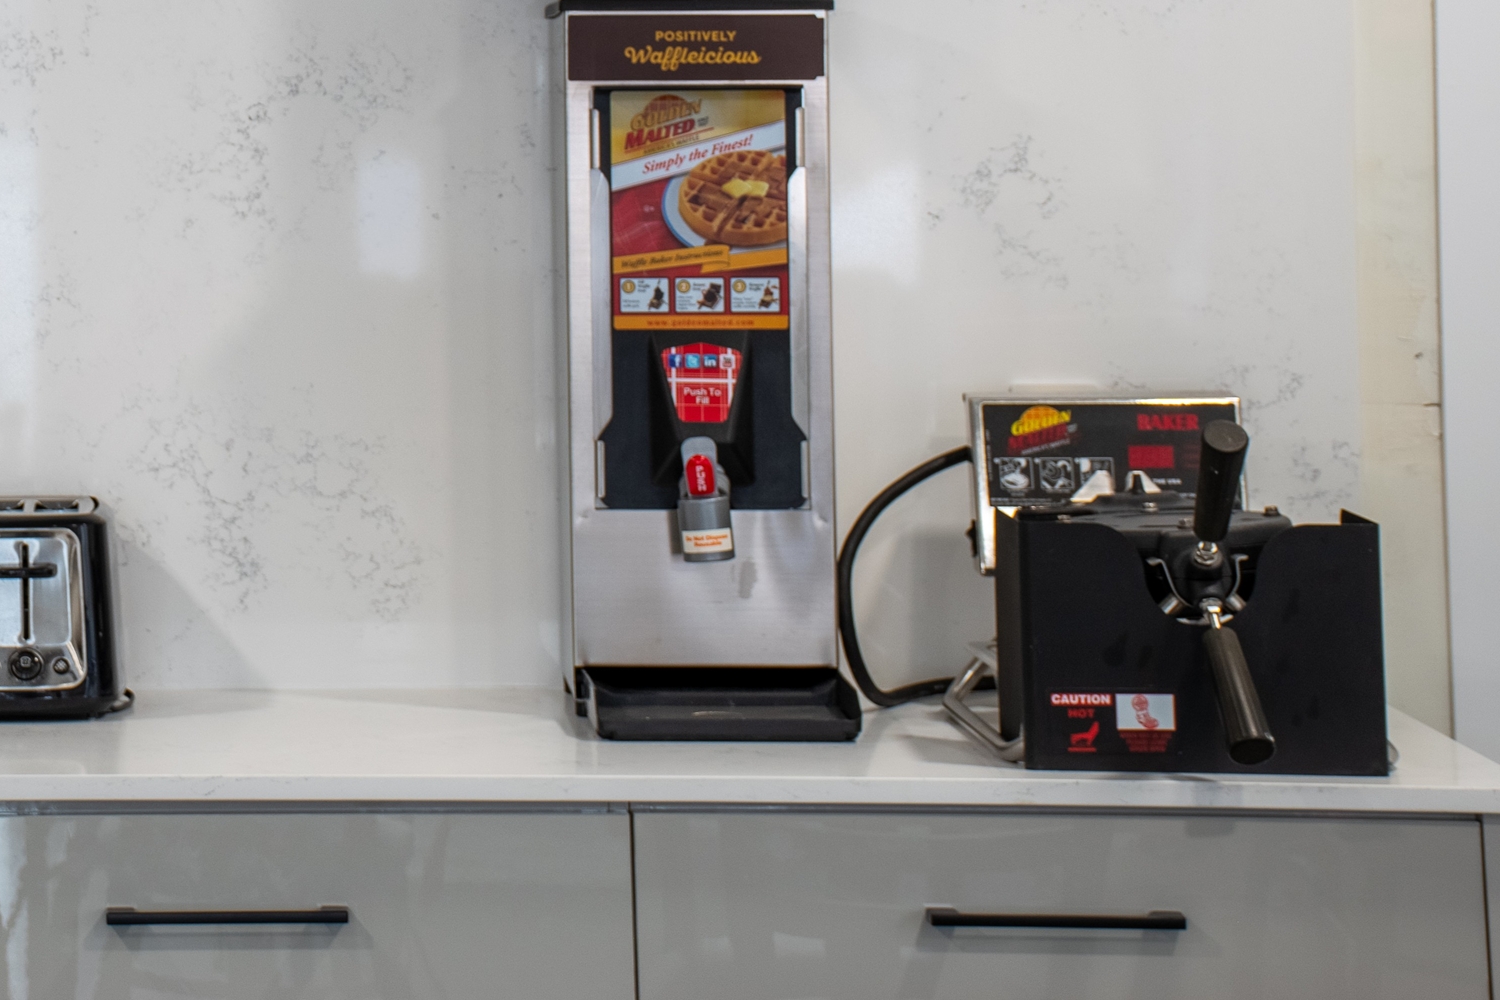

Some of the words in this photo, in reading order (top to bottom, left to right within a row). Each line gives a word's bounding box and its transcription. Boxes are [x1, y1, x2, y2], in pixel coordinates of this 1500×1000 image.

[655, 30, 737, 42] POSITIVELY
[624, 45, 761, 71] Waffleicious
[630, 99, 703, 131] GOLDEN
[624, 118, 696, 150] MALTED
[642, 153, 686, 174] Simply
[688, 148, 708, 162] the
[711, 134, 754, 155] Finest!
[683, 387, 708, 397] Push
[708, 387, 722, 397] To
[695, 396, 710, 405] Fill
[1137, 413, 1199, 430] BAKER
[1051, 694, 1111, 705] CAUTION
[1067, 708, 1094, 719] HOT
